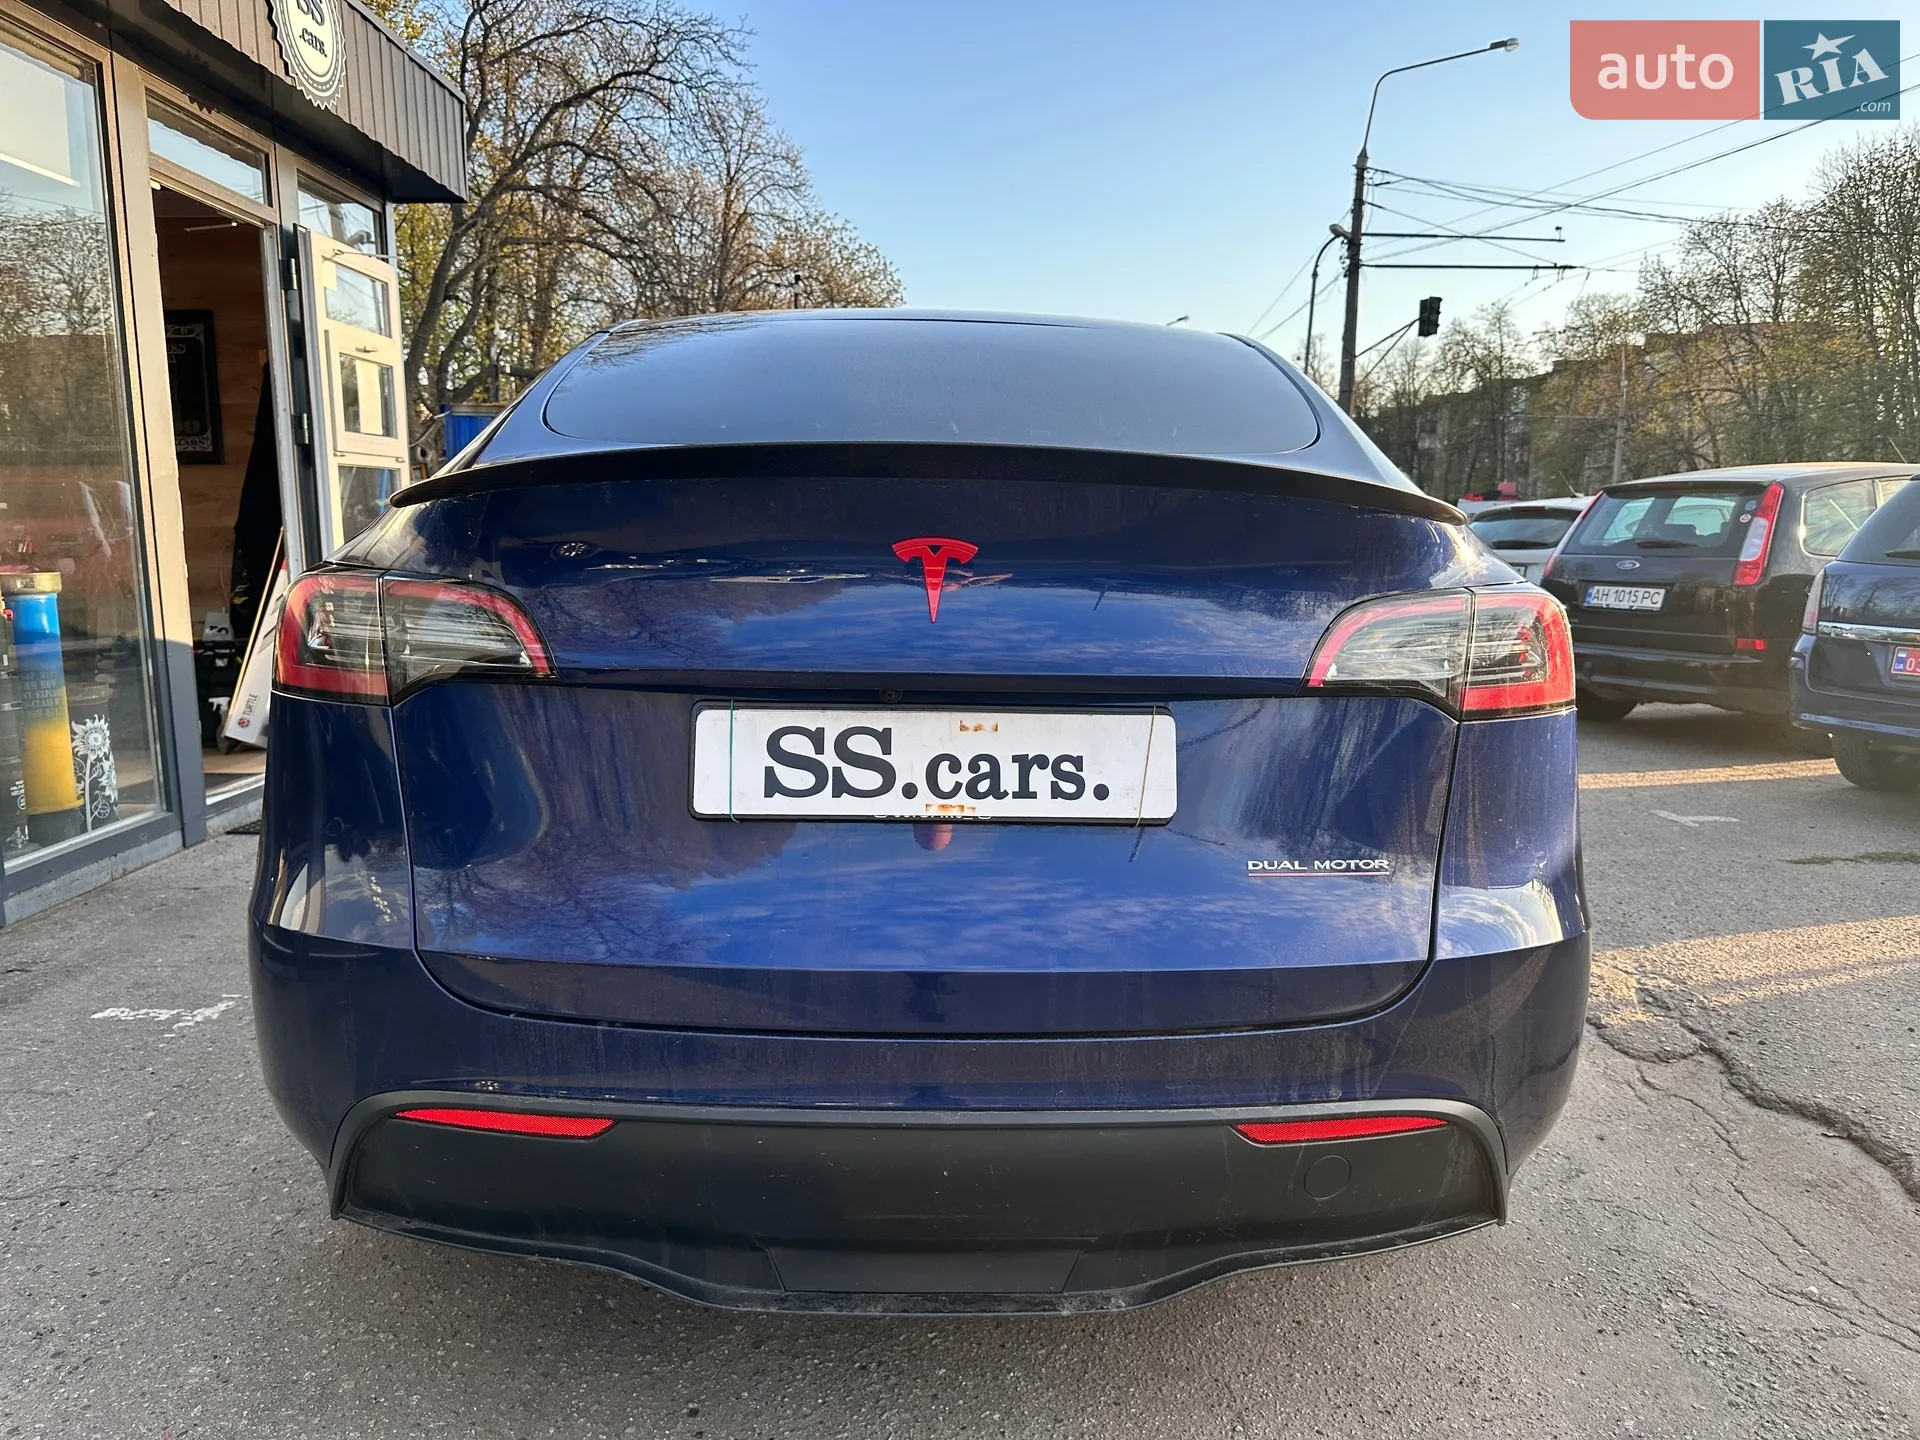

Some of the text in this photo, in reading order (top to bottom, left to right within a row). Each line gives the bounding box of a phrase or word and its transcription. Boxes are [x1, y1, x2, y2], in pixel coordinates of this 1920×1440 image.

[1592, 588, 1660, 605] AH 1015 PC
[242, 692, 258, 716] TURTLE
[763, 725, 1110, 801] SS.cars.
[1247, 859, 1390, 870] DUAL MOTOR
